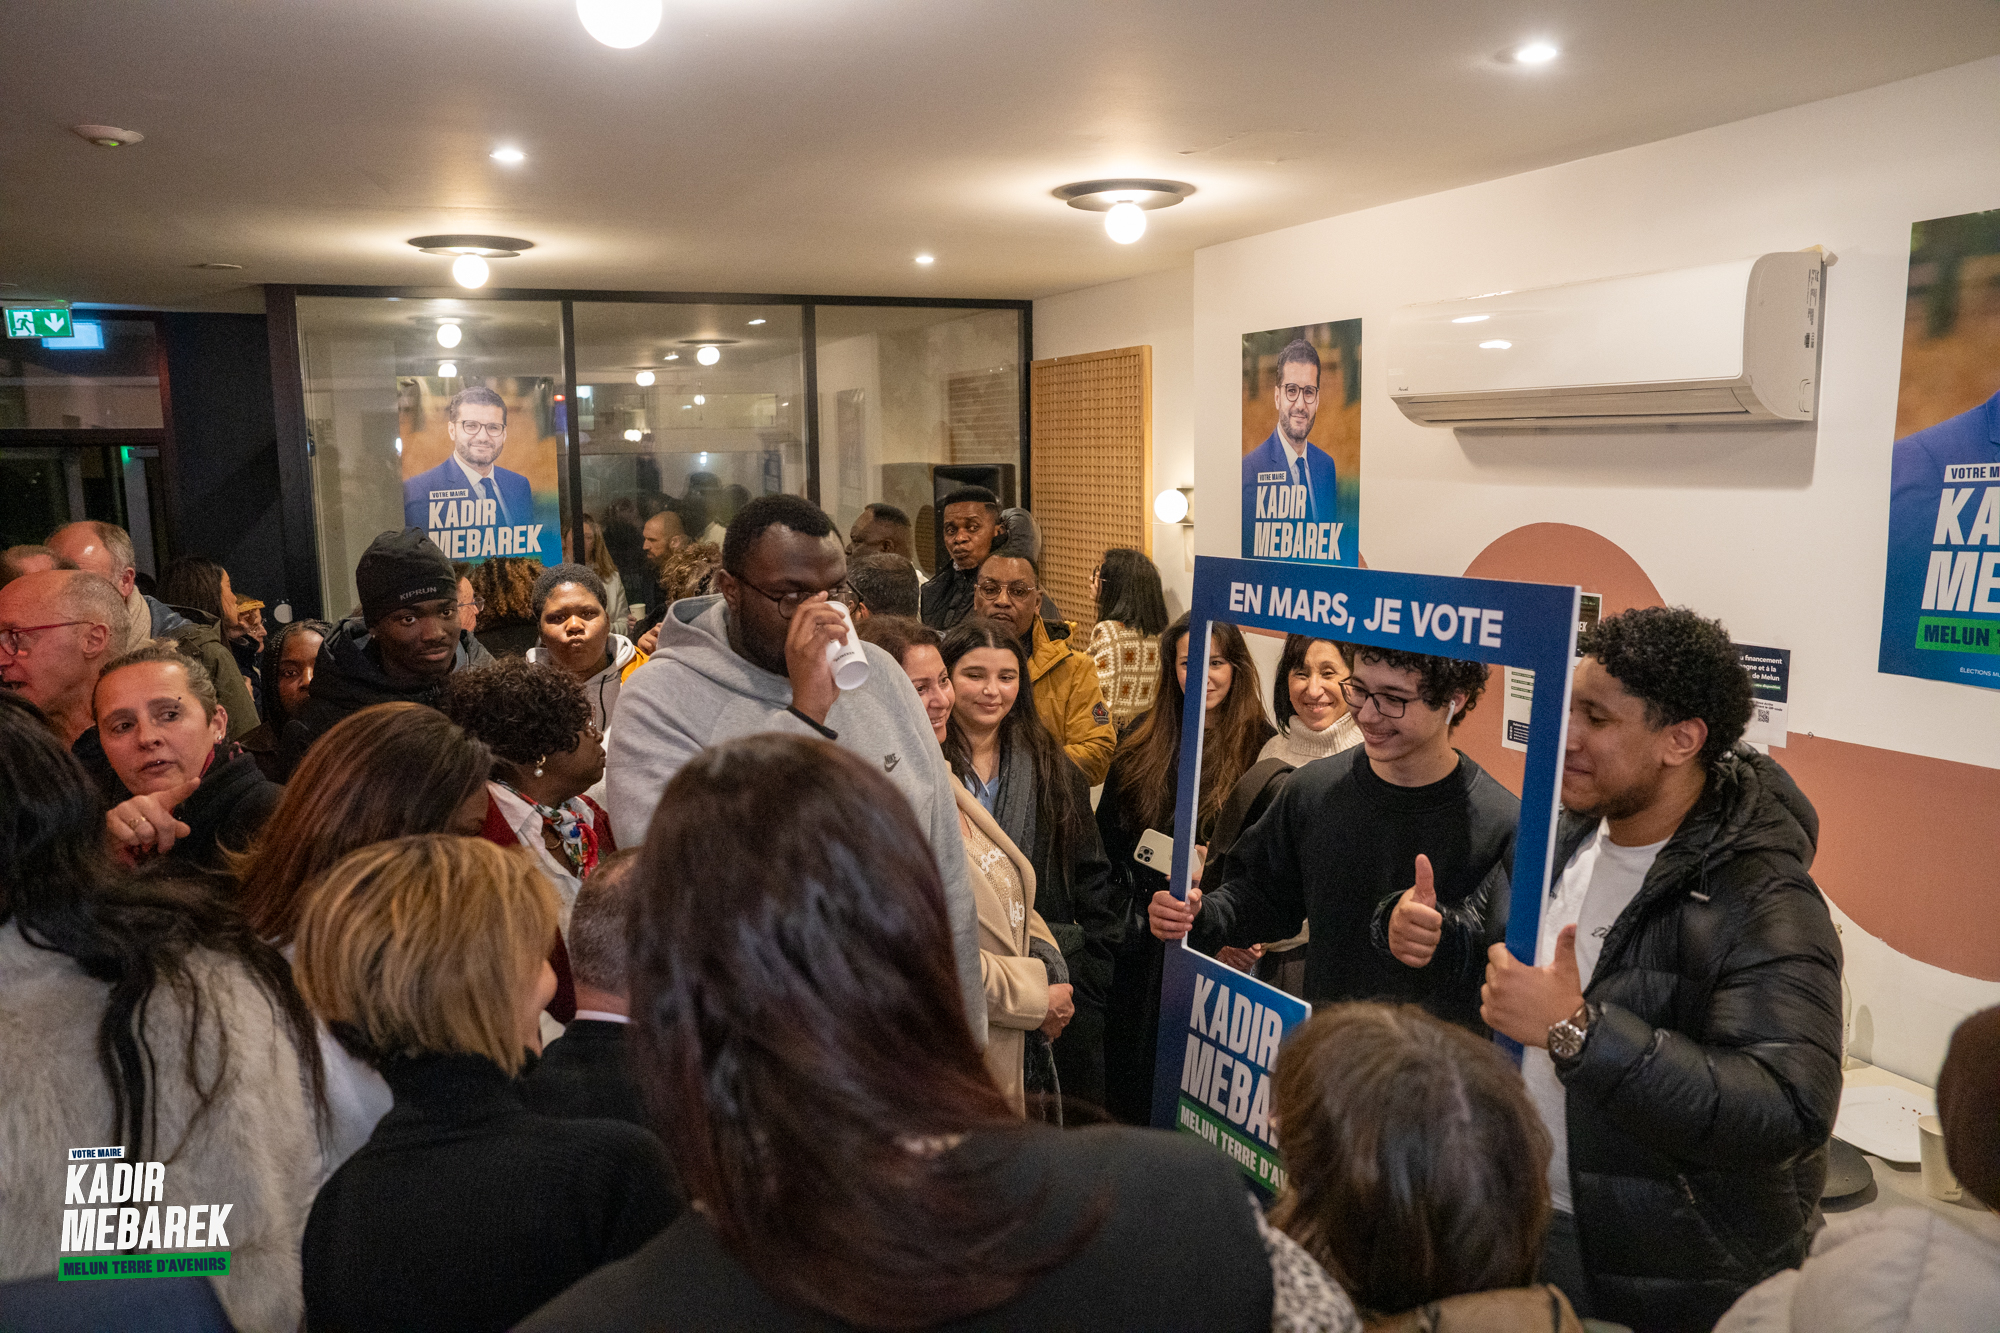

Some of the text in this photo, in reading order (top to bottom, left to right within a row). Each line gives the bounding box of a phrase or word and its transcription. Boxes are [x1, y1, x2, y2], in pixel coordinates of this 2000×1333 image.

[1951, 467, 1986, 479] VOTRE
[428, 499, 497, 529] KADIR
[1255, 485, 1307, 519] KADIR
[428, 524, 544, 559] MEBAREK
[1253, 521, 1344, 560] MEBAREK
[400, 586, 437, 600] KIPRUN
[1229, 581, 1504, 648] EN MARS, JE VOTE
[1923, 624, 1990, 647] MELUN
[1745, 655, 1783, 665] financement
[1960, 667, 1991, 677] ÉLECTIONS
[1761, 673, 1780, 681] Melun
[884, 753, 896, 763] NIKE
[1189, 973, 1283, 1073] KADIR
[1180, 1104, 1217, 1146] MELUN
[1221, 1130, 1257, 1172] TERRE
